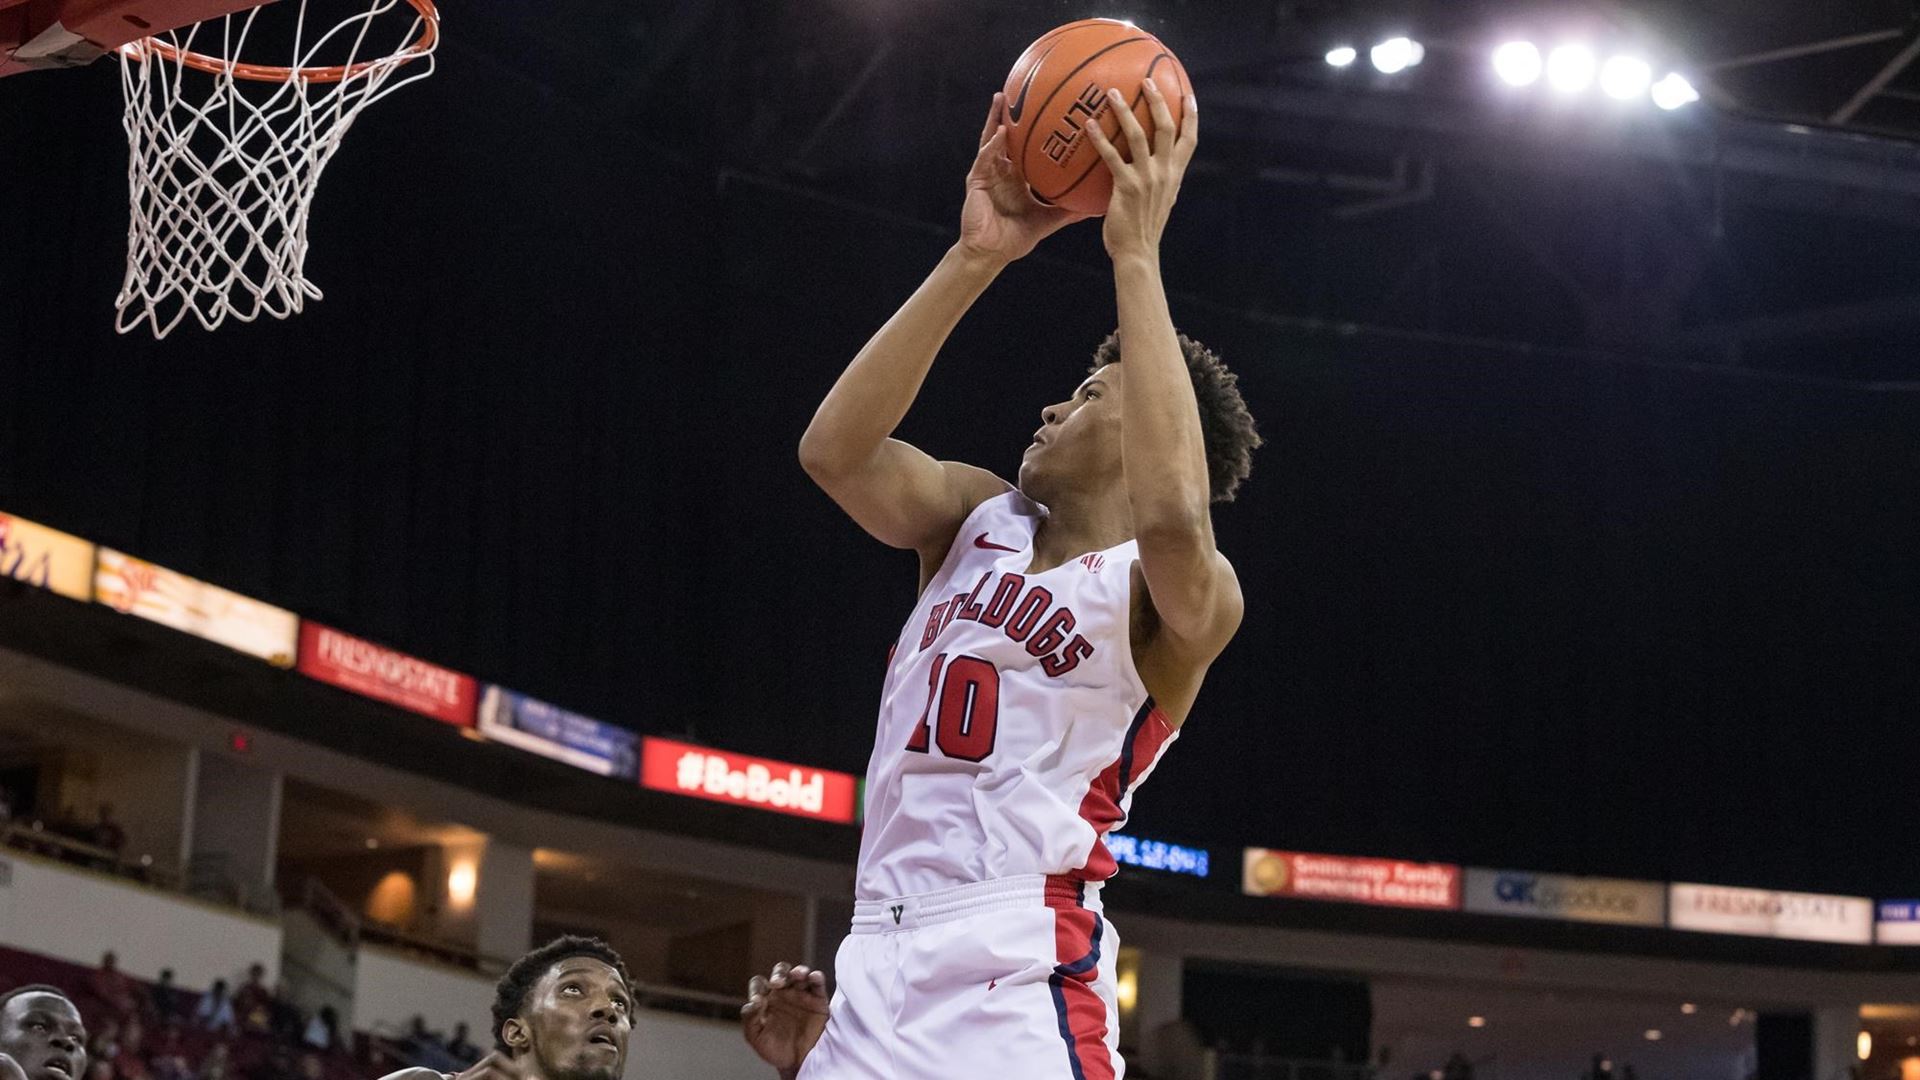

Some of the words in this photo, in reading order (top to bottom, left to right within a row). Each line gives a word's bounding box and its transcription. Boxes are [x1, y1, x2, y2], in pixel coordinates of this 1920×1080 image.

[1042, 82, 1107, 162] ELITE
[918, 570, 1095, 678] BLDOGS
[904, 652, 1001, 763] 10
[676, 751, 824, 814] #BeBold
